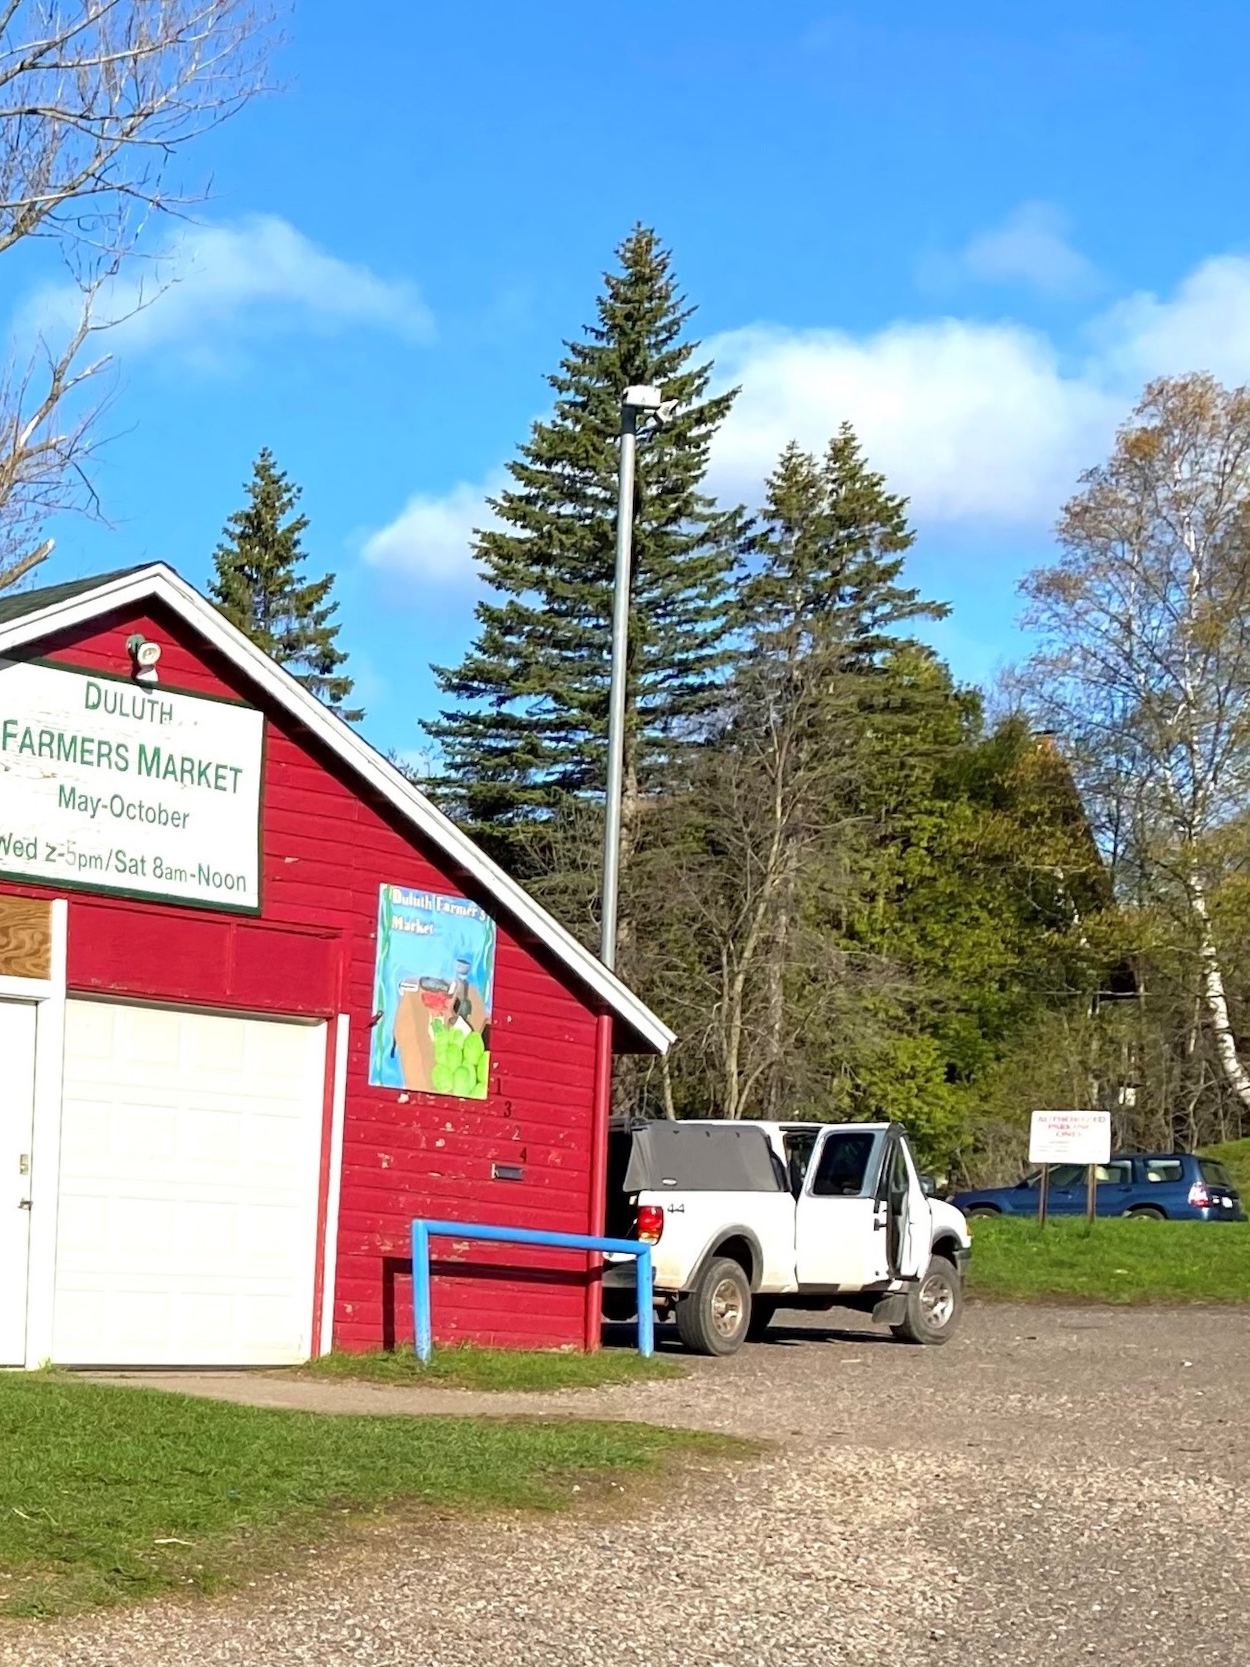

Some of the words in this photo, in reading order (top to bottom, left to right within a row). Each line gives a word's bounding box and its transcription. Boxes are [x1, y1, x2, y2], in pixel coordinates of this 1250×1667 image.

[85, 681, 173, 724] DULUTH
[1, 719, 130, 773] FARMERS
[137, 743, 243, 794] MARKET
[58, 783, 191, 829] May-October
[152, 856, 247, 893] 8am-Noon
[392, 888, 433, 911] Duluth
[435, 896, 487, 921] Farmers
[392, 915, 434, 935] Market
